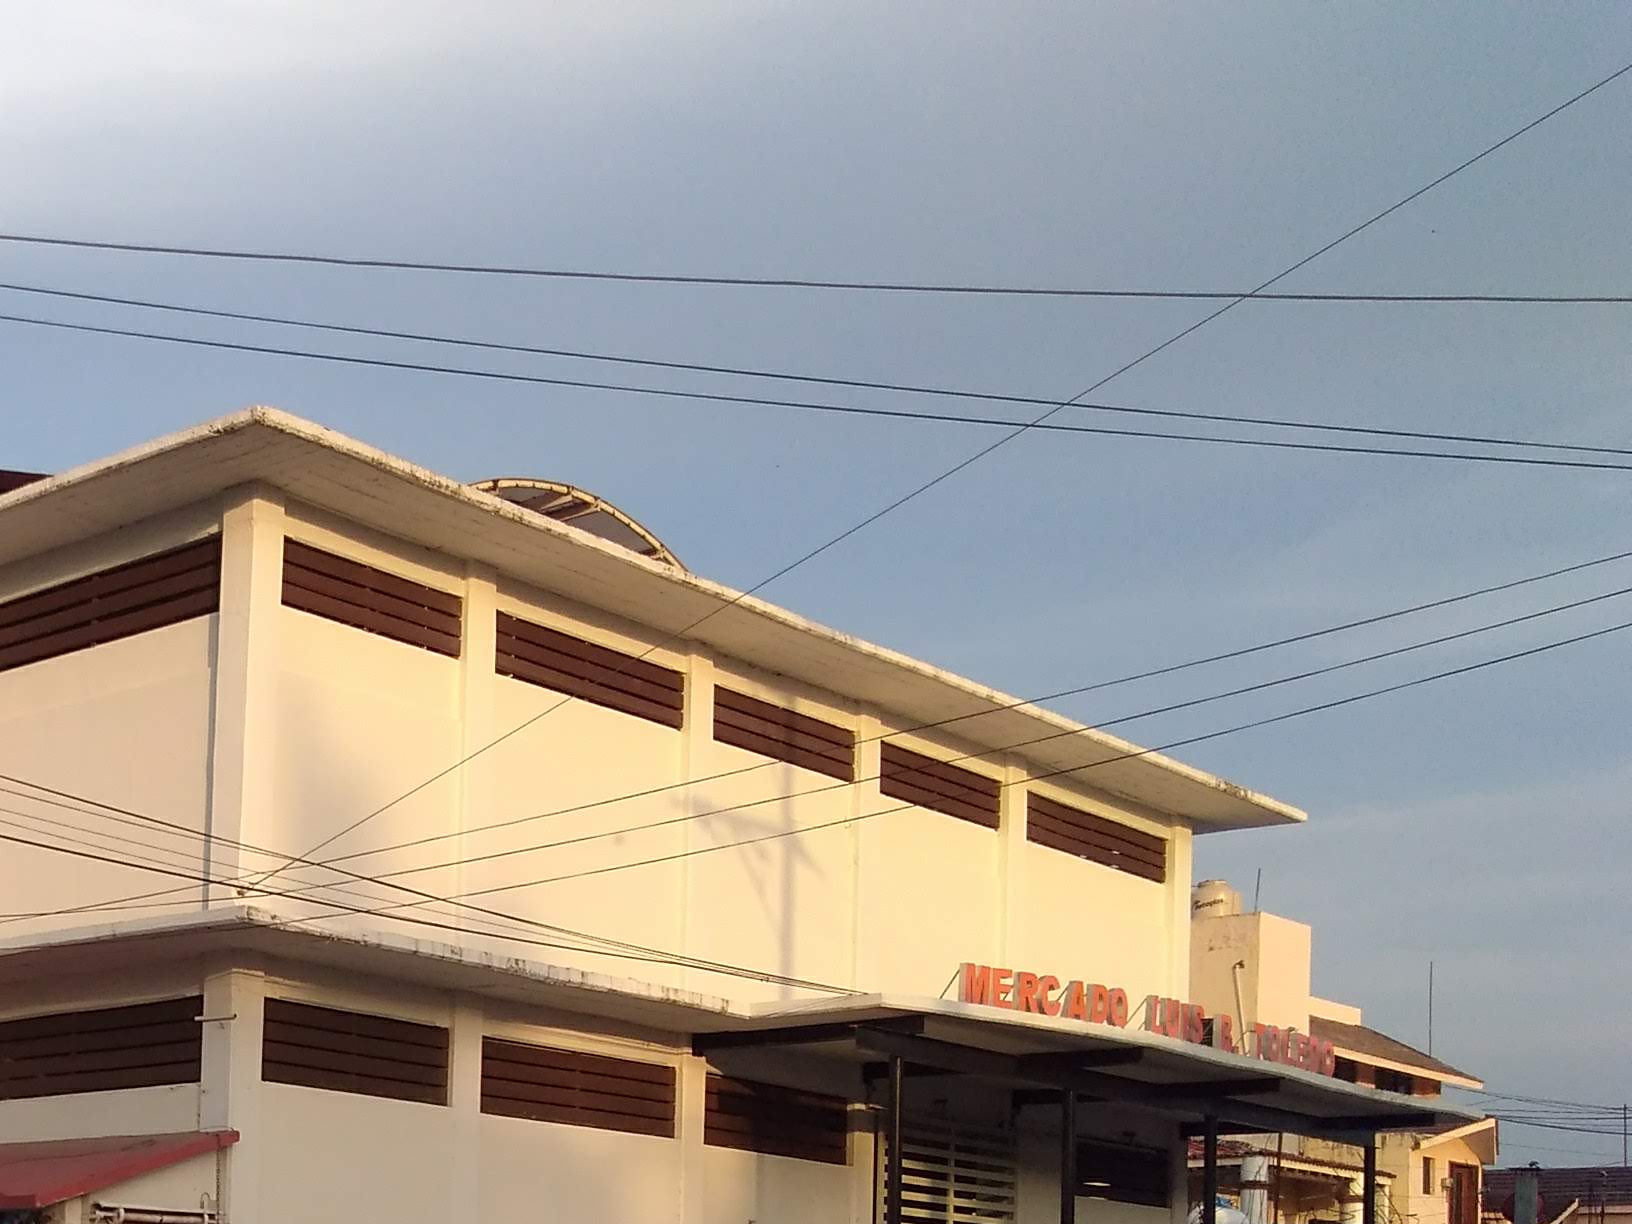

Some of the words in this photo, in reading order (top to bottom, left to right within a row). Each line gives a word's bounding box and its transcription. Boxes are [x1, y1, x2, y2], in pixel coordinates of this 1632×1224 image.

[958, 962, 1129, 1029] MERCADO
[1145, 994, 1204, 1044] LUIS
[1246, 1021, 1335, 1078] TOLEDO
